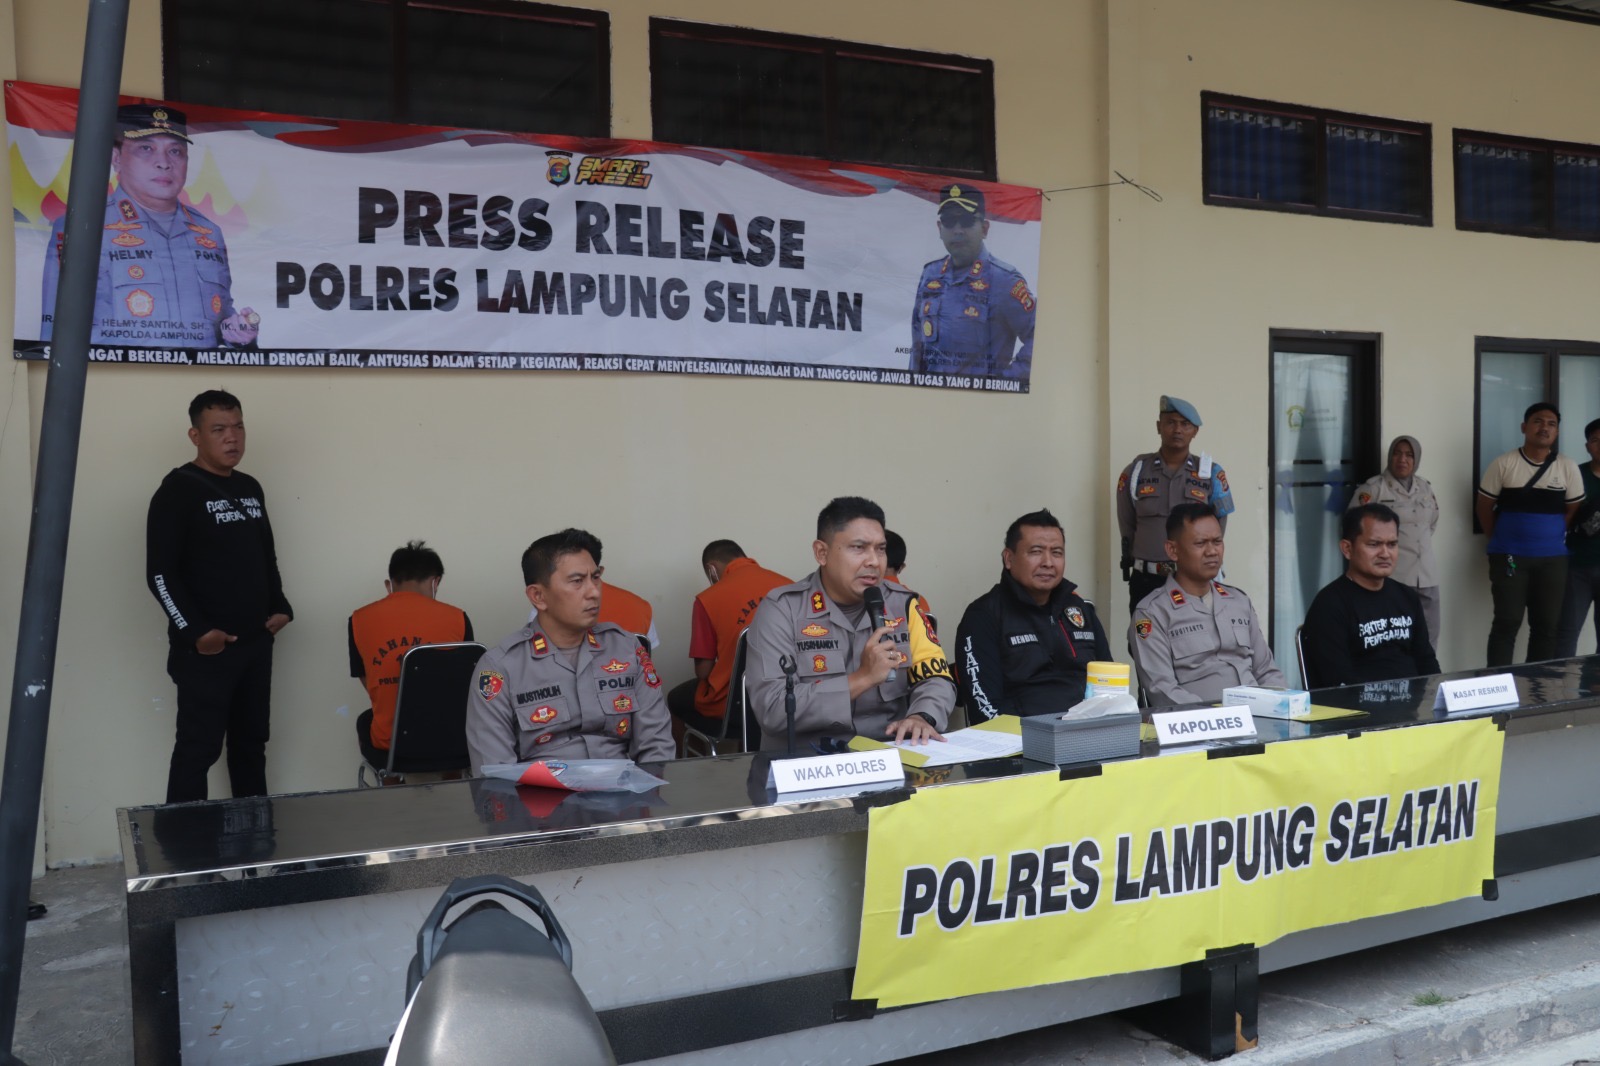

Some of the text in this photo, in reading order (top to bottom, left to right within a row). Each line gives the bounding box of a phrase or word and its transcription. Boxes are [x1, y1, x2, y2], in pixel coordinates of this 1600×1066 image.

[580, 157, 649, 174] SMART
[576, 171, 652, 188] PRESISI
[358, 186, 805, 269] PRESS RELEASE
[109, 250, 153, 261] HELMY
[276, 261, 863, 332] POLRES LAMPUNG SELATAN
[102, 319, 139, 327] HELMY
[101, 330, 205, 341] KAPOLDA LAMPUNG
[44, 346, 1020, 392] SNGAT BEKERJA, MELAYANI DENGAN BAIK, ANTUSIAS DALAM SETIAP KEGIATAN, REAKSI CEPAT MENYELESAIKAN MASALAH DAN TANGGGUNG JAWAB TUGAS YANG DI BERIKAN
[1389, 615, 1413, 628] SQUAD
[910, 658, 949, 682] KAOP
[964, 635, 998, 720] JATANR
[599, 677, 635, 691] POLRI
[1453, 685, 1508, 699] KASAT RESKRIM
[1168, 716, 1243, 735] KAPOLRES
[793, 759, 887, 781] WAKA POLRES
[898, 779, 1479, 937] POLRES LAMPUNG SELATAN
